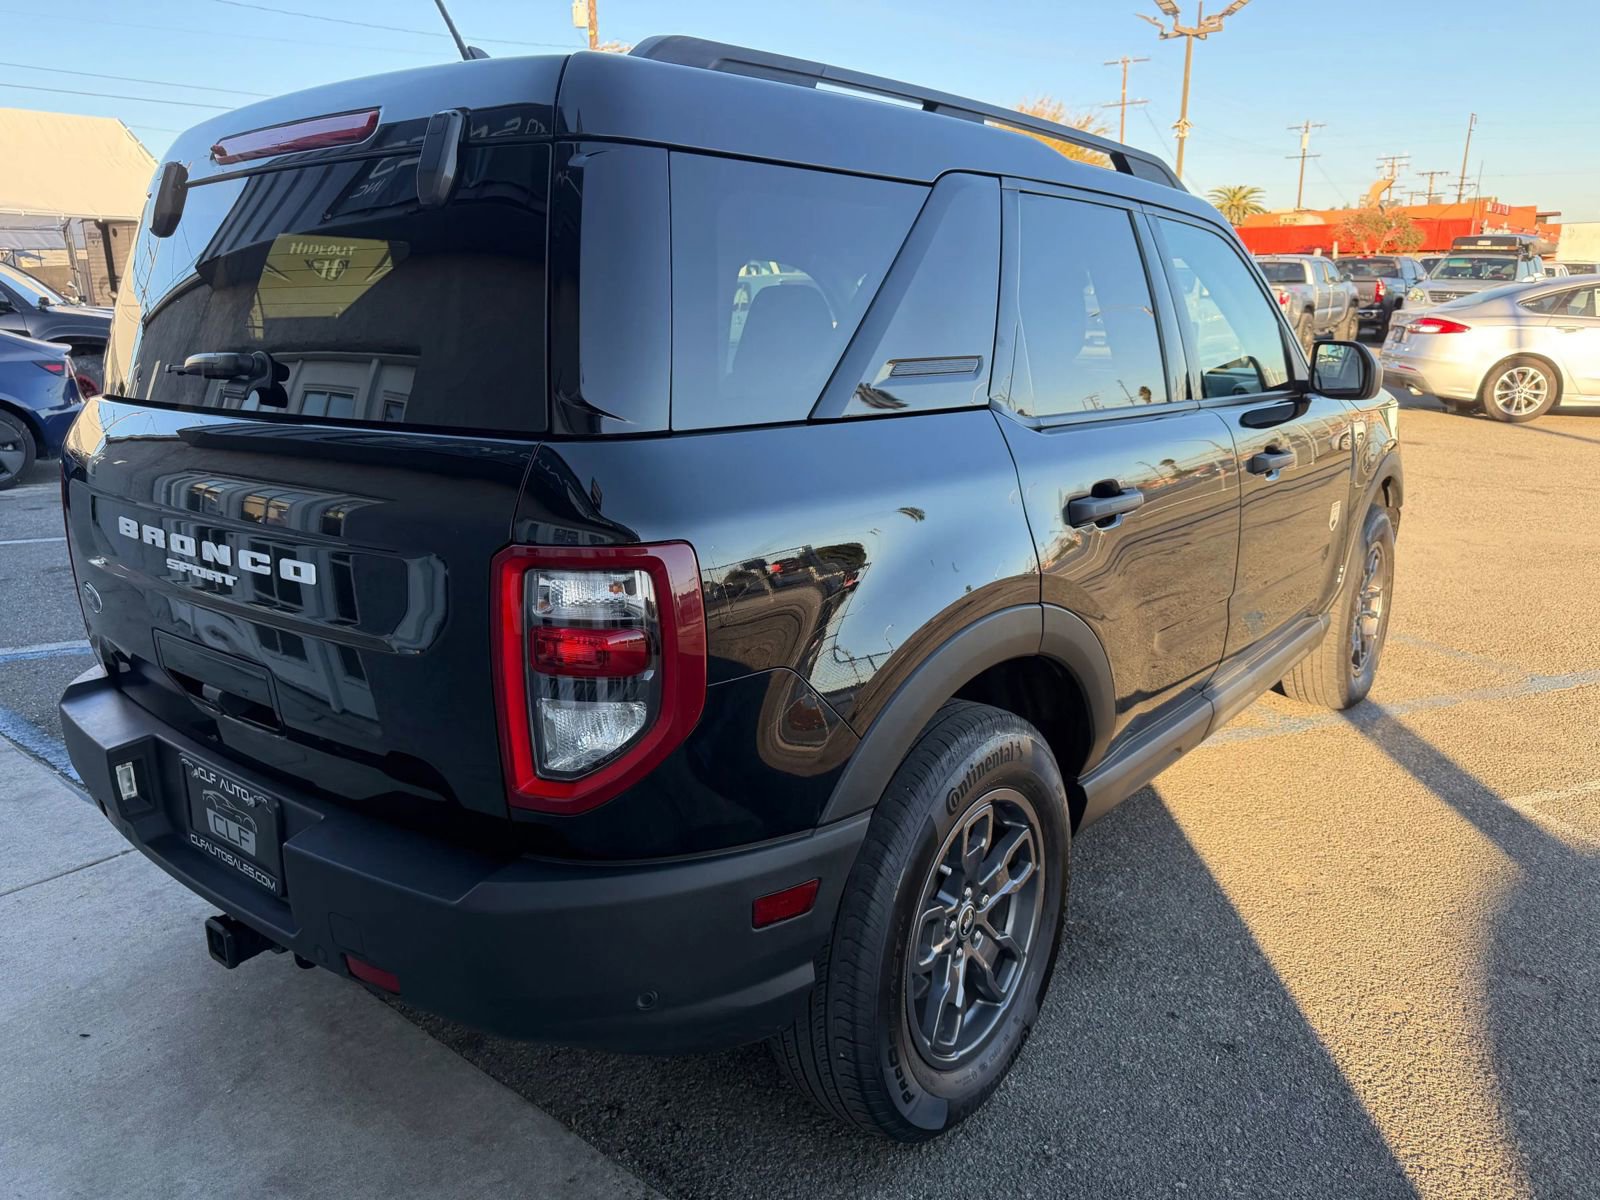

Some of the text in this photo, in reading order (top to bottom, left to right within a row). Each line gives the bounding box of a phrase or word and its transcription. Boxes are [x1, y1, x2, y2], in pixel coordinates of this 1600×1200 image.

[289, 242, 358, 257] HIDEOUT
[118, 516, 316, 585] BRONCO
[166, 558, 239, 586] SPORT
[197, 767, 250, 801] CLF AUTO
[945, 741, 1014, 816] Continental
[213, 814, 250, 847] CLF
[190, 833, 277, 892] CLFAUTOSALES.COM
